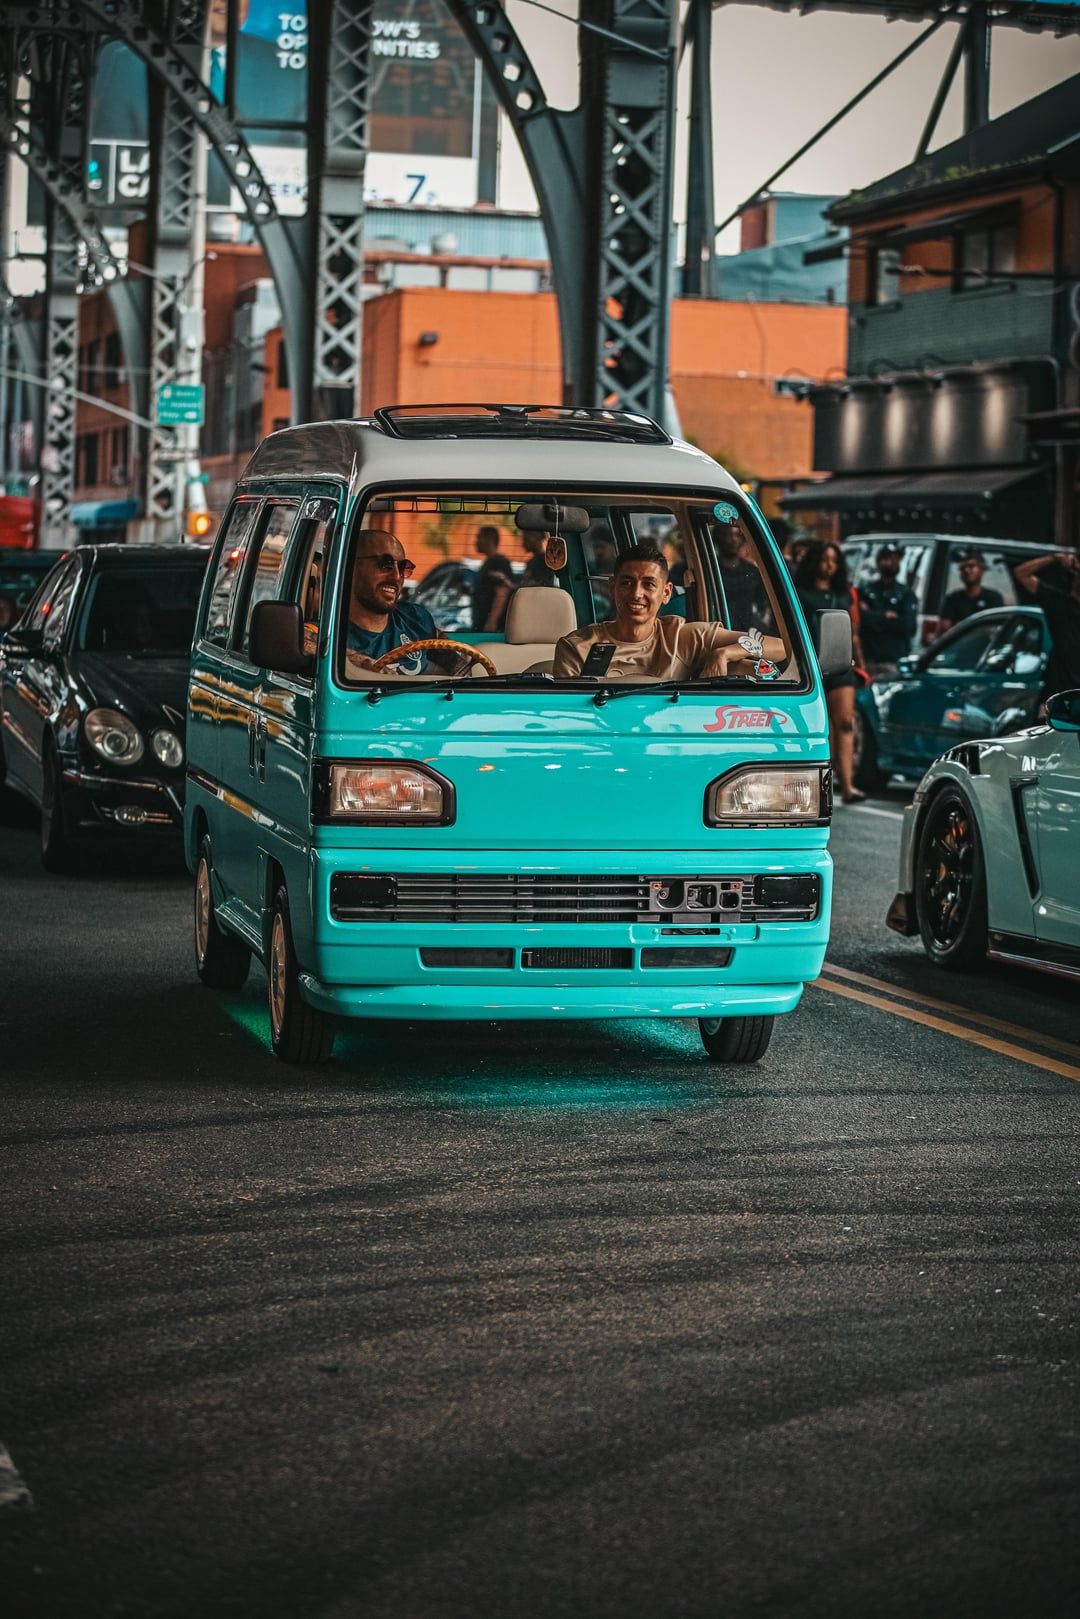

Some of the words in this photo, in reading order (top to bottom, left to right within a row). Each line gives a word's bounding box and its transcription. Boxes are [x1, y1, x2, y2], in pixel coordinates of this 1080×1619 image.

[278, 13, 307, 31] TO
[276, 52, 306, 69] TO
[703, 705, 788, 732] STREET
